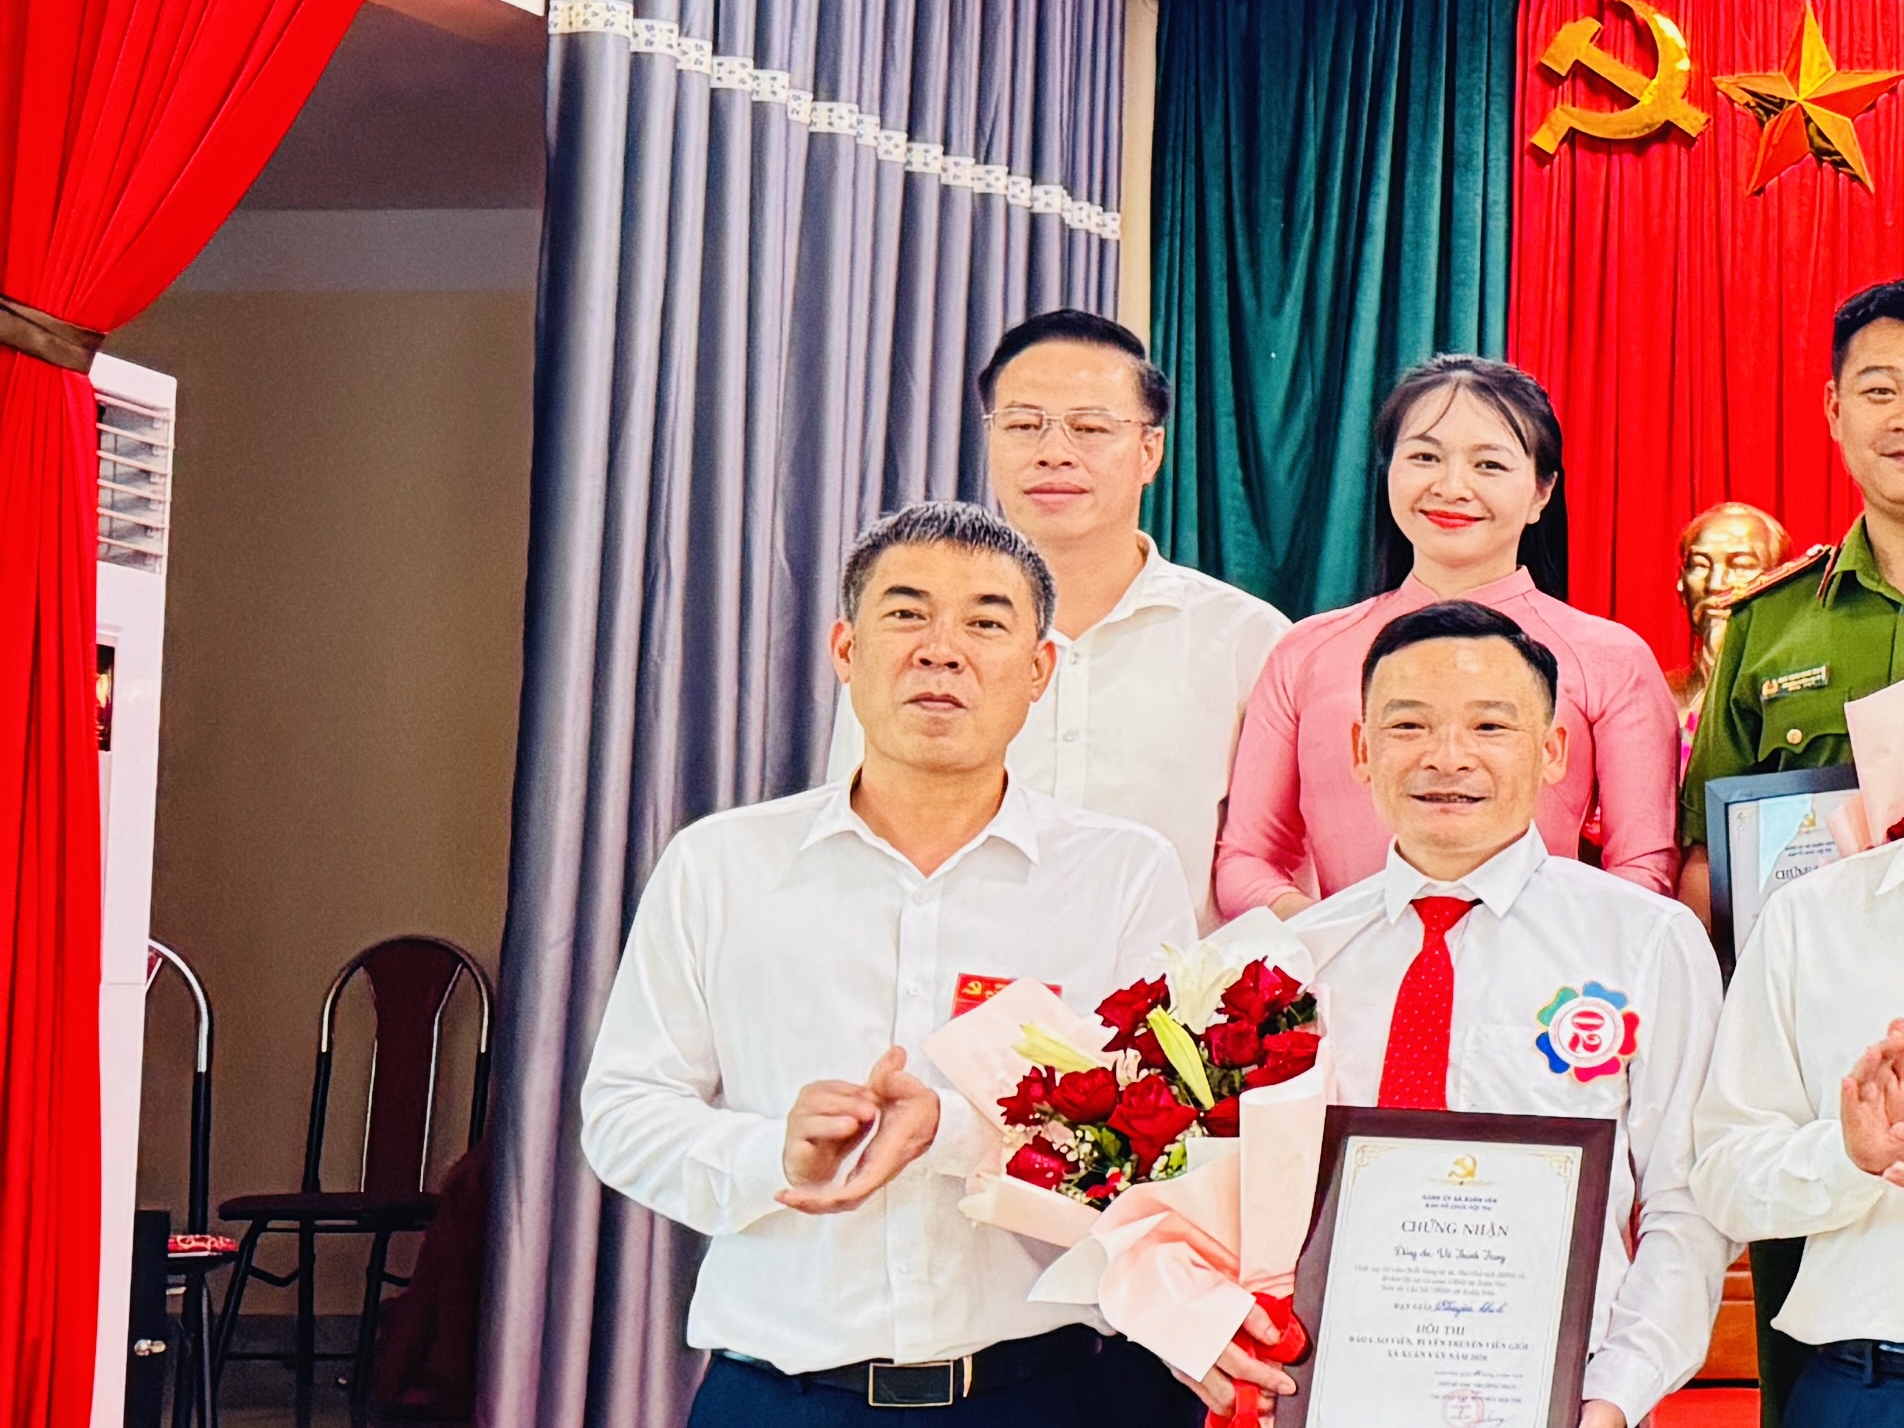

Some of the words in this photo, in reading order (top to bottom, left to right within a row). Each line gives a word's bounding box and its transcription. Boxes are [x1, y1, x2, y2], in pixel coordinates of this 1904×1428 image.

[1568, 1010, 1605, 1053] 02
[1401, 1219, 1458, 1235] CHỨNG
[1462, 1221, 1510, 1239] NHẬN
